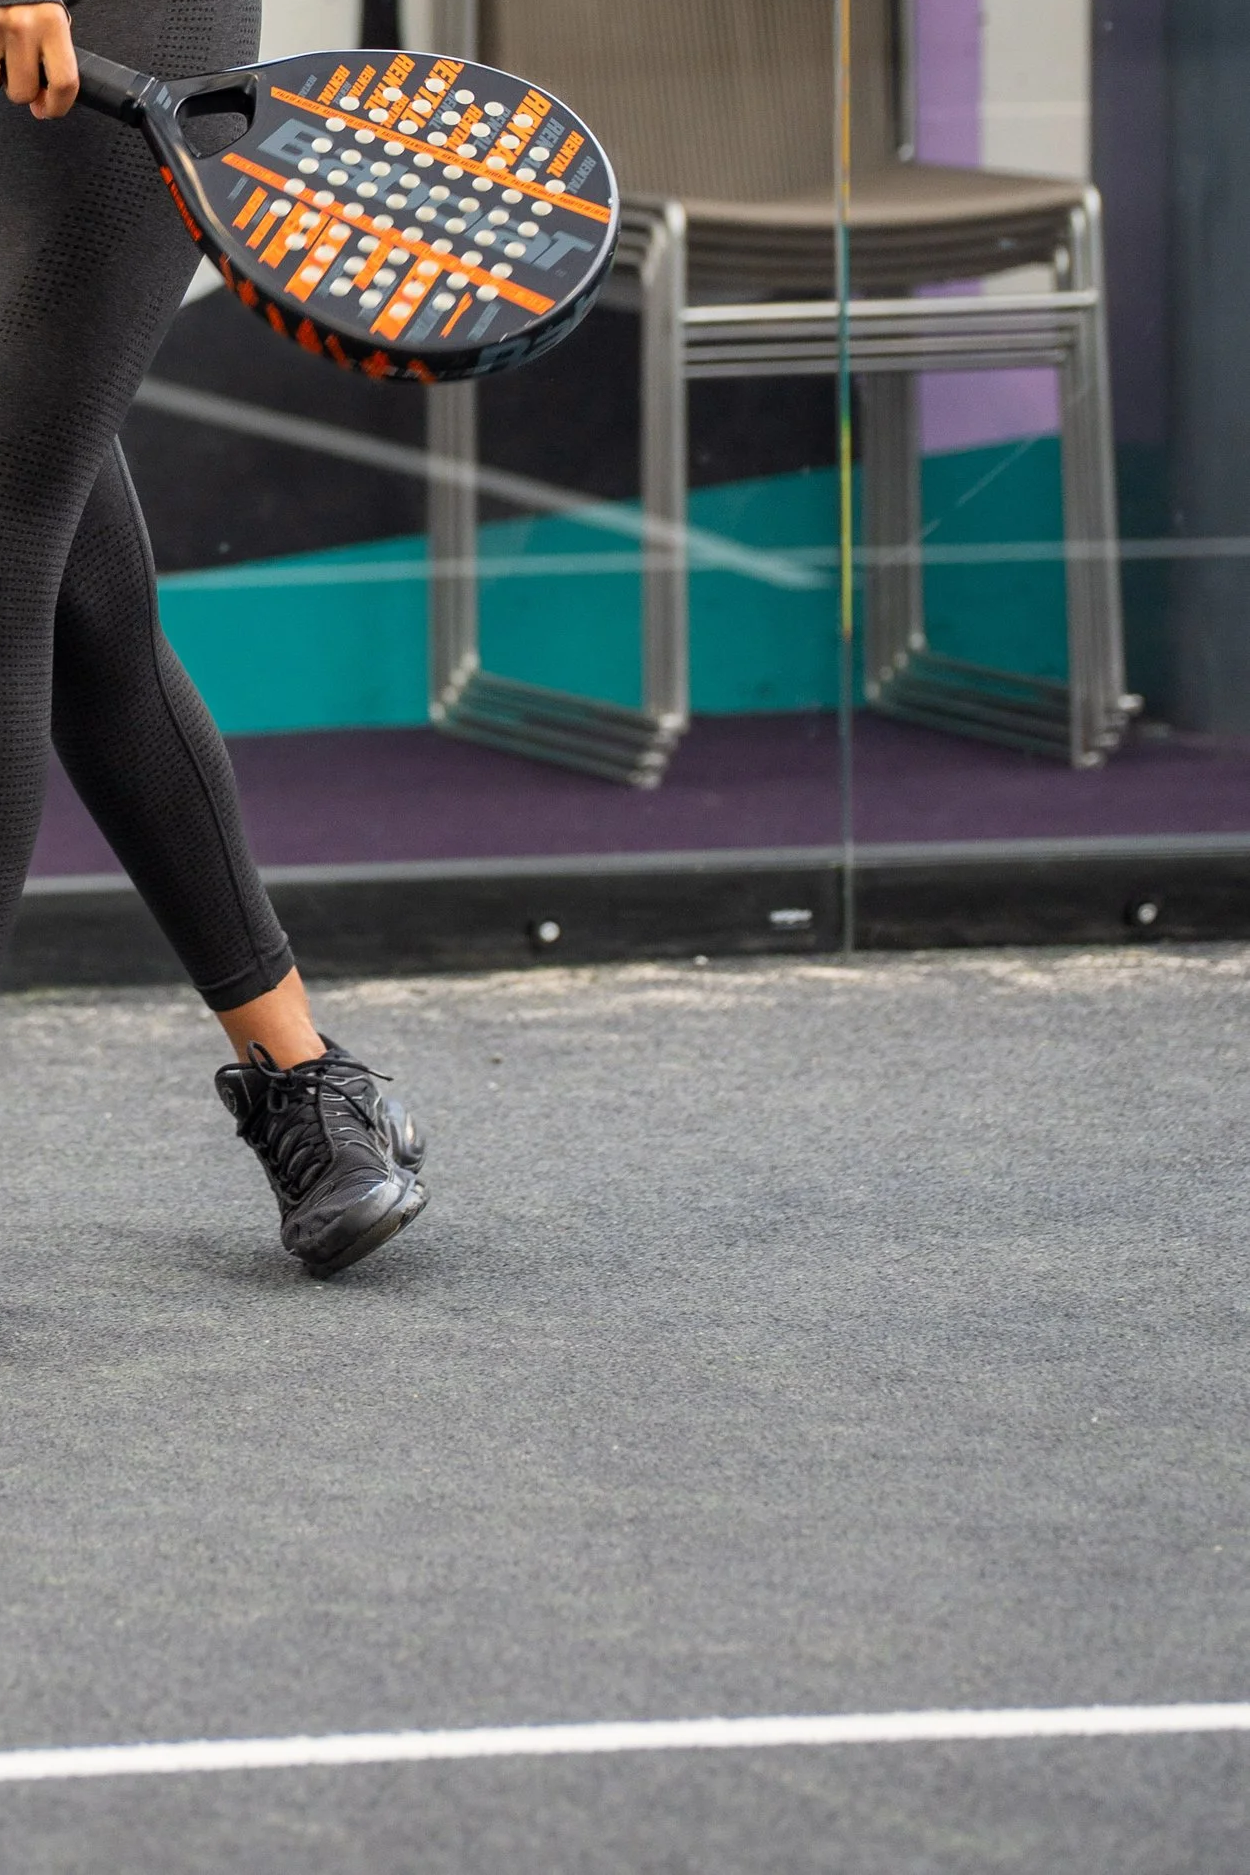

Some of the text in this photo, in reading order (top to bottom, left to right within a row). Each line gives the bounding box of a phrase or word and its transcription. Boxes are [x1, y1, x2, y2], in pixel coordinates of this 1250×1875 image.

[317, 64, 350, 105] RENTAL
[343, 64, 377, 103] RENTA
[546, 130, 585, 179] RENTAL
